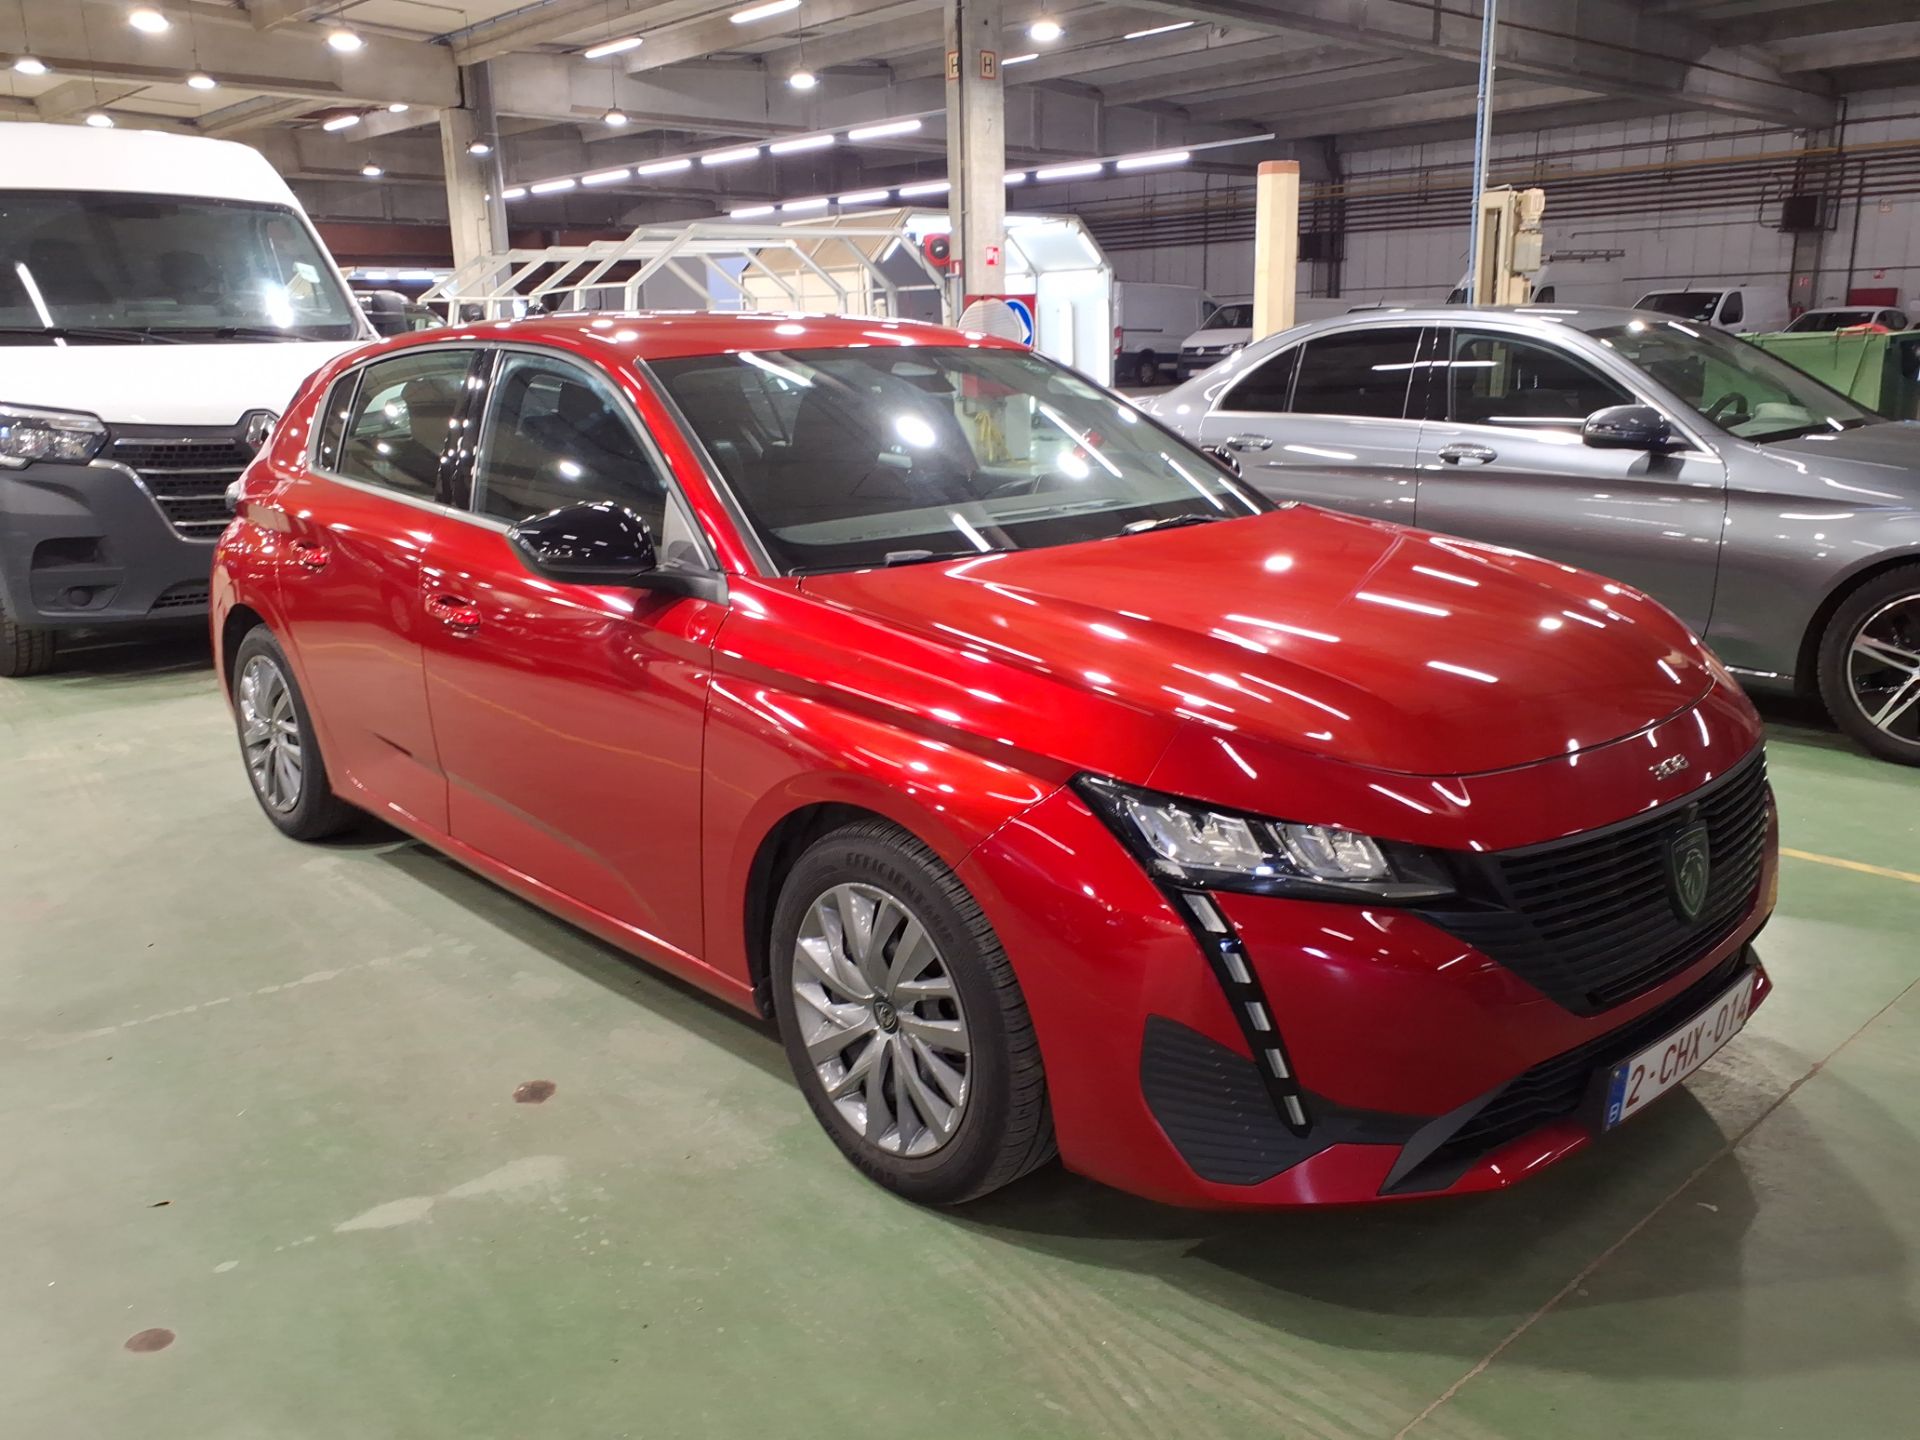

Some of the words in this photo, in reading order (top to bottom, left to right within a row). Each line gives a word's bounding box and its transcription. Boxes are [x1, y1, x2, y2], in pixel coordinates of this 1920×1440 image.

[983, 56, 993, 73] H
[1625, 984, 1751, 1109] 2-CHX-014
[1608, 1102, 1621, 1124] B
